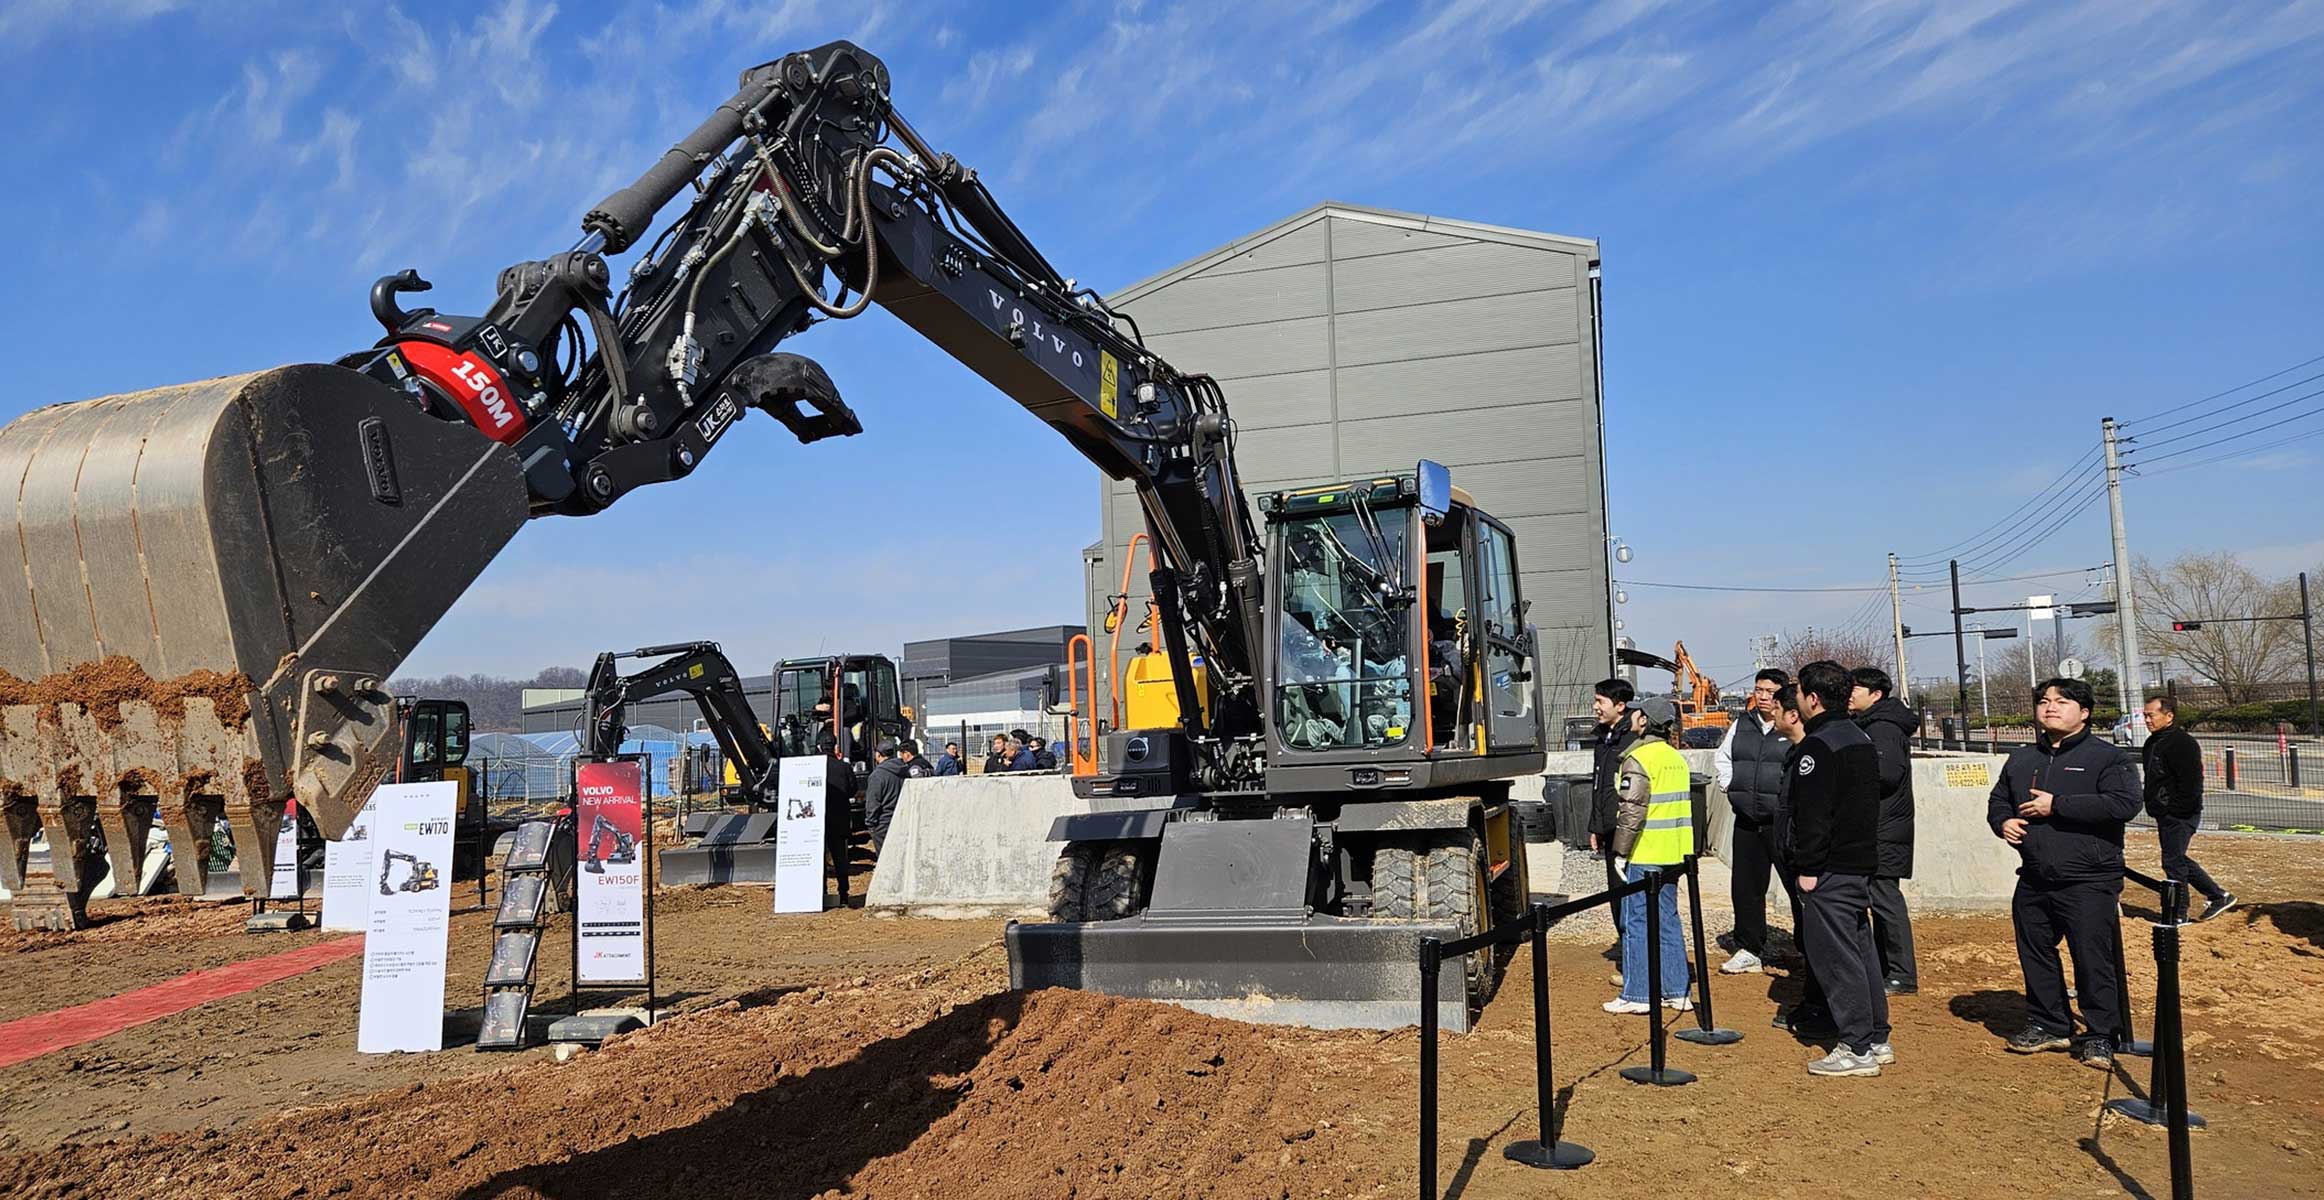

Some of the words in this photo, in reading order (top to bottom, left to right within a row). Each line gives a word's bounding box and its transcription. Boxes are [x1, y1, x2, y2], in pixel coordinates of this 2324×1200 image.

[988, 288, 1083, 368] VOLVO
[485, 331, 503, 351] JK
[450, 360, 514, 429] 150M
[702, 413, 721, 437] JK
[655, 672, 689, 688] VOLVO
[582, 786, 614, 796] VOLVO
[582, 796, 602, 806] NEW
[602, 795, 638, 805] ARRIVAL
[418, 822, 449, 836] EW170
[598, 875, 640, 885] EW150F
